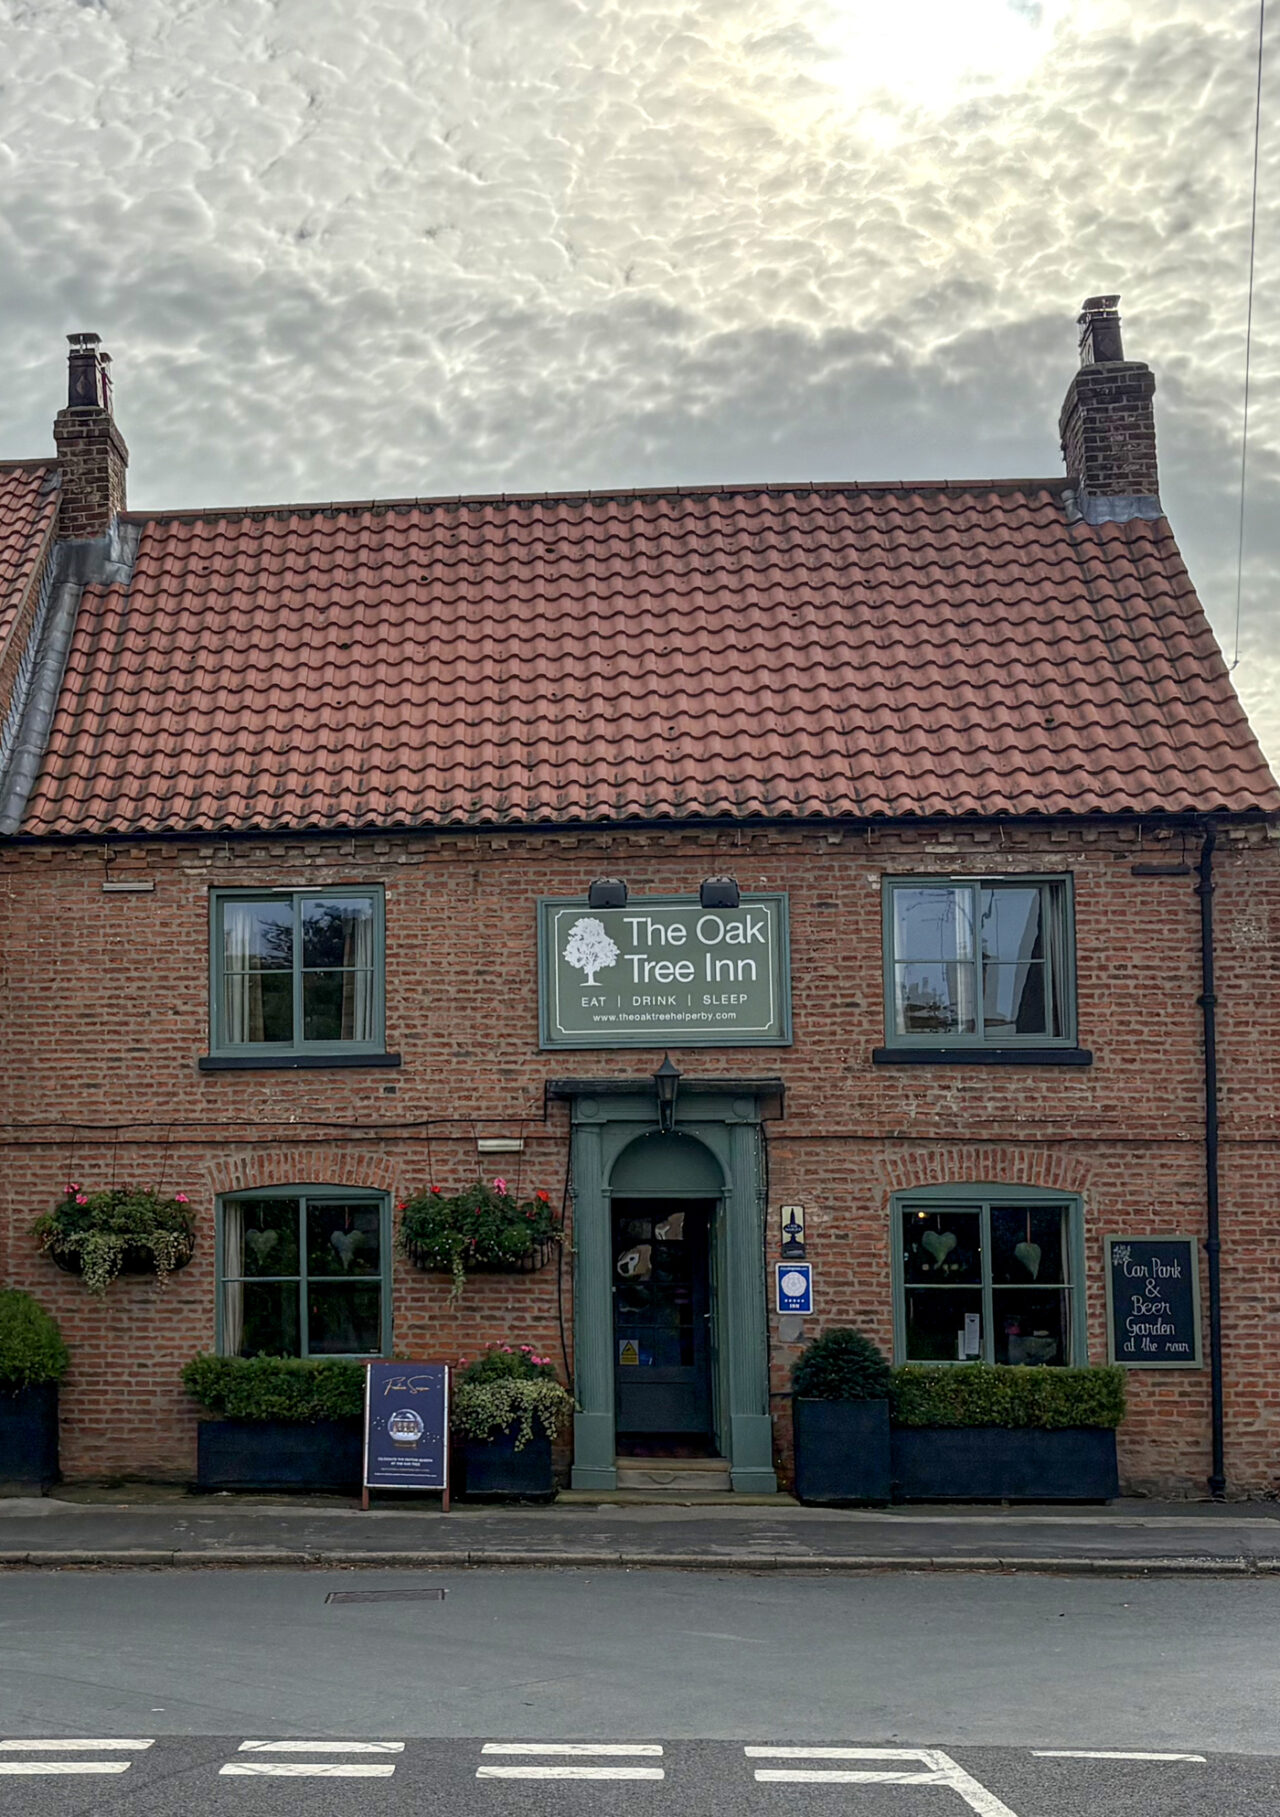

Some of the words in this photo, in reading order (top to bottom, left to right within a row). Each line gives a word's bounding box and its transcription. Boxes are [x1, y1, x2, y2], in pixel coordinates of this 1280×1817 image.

[623, 917, 687, 946] The
[696, 914, 766, 945] Oak
[624, 954, 694, 984] Tree
[705, 952, 757, 982] Inn
[581, 996, 607, 1007] EAT
[632, 995, 677, 1006] DRINK
[703, 994, 748, 1005] SLEEP
[593, 1011, 736, 1023] www.theoaktreehelperby.com
[1123, 1260, 1149, 1278] Car
[1152, 1258, 1181, 1279] Park
[1145, 1278, 1161, 1297] &
[1131, 1295, 1171, 1315] Beer
[1123, 1337, 1135, 1352] at
[1141, 1338, 1158, 1352] the
[1165, 1341, 1190, 1352] rear
